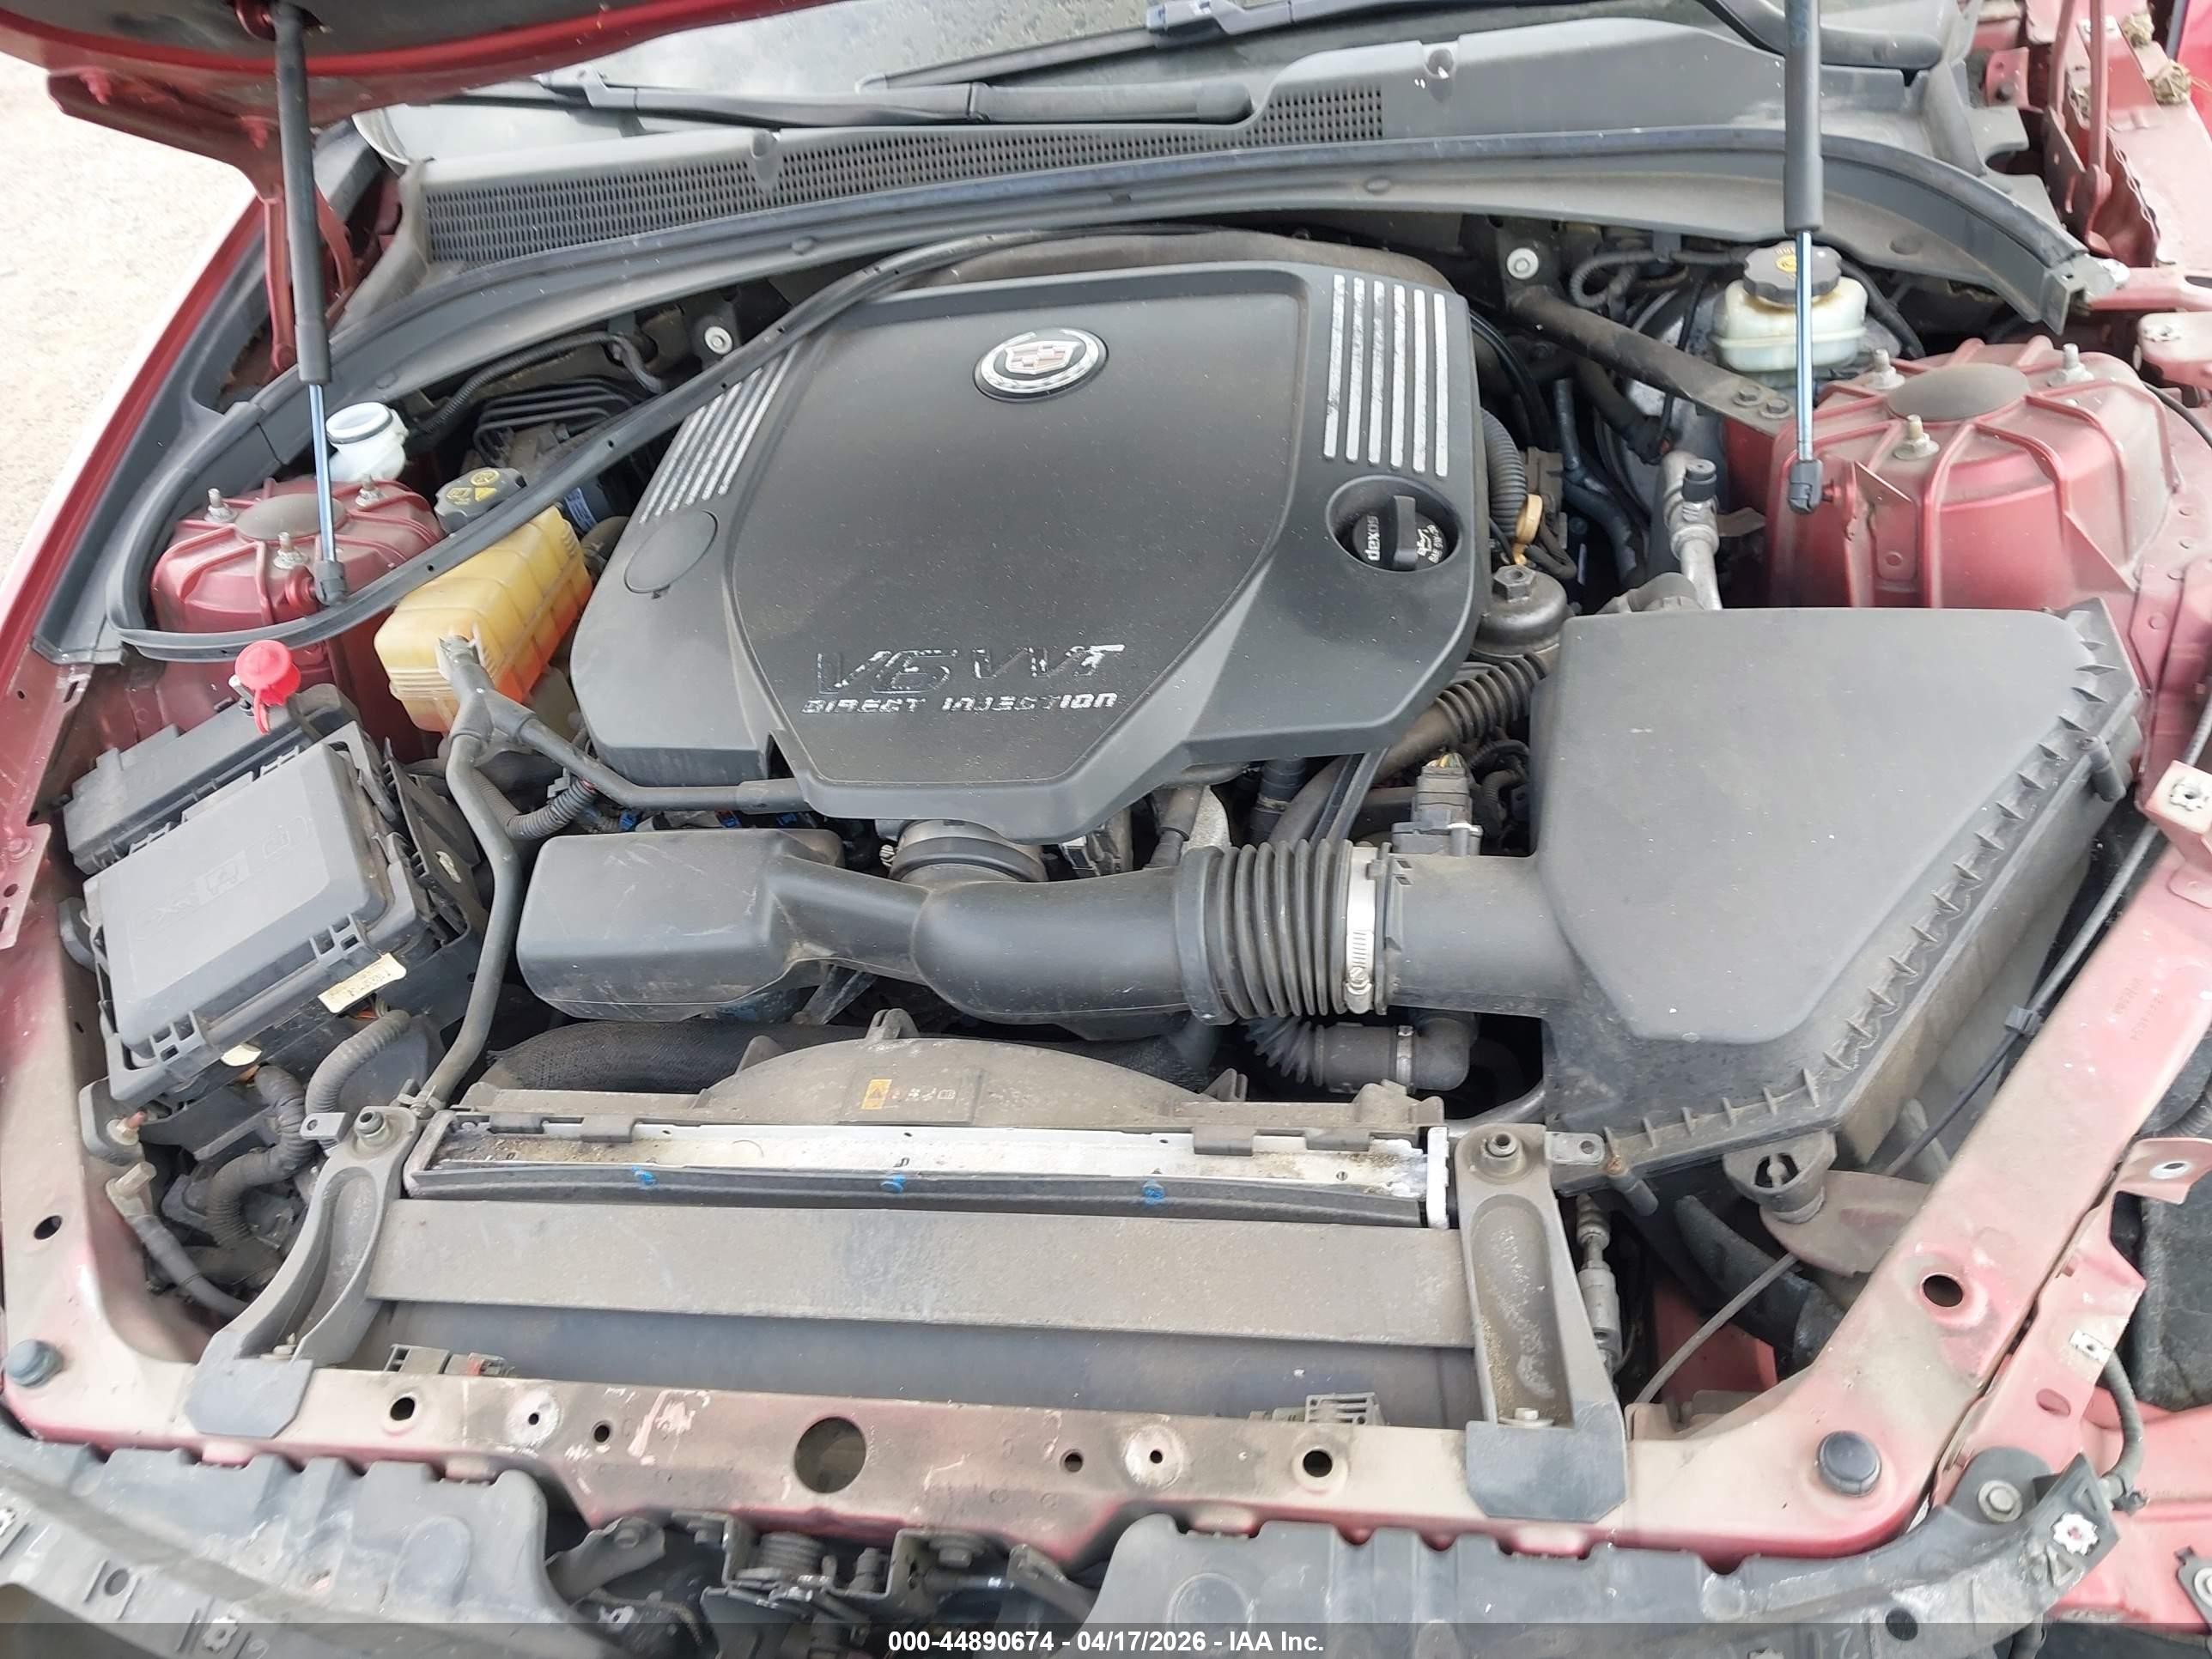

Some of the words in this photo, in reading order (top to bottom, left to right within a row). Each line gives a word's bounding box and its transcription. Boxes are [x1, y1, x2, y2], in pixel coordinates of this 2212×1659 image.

[1364, 515, 1381, 561] dexos
[817, 650, 957, 694] V6
[801, 696, 927, 714] DIRECT
[942, 693, 1118, 713] INJECTION
